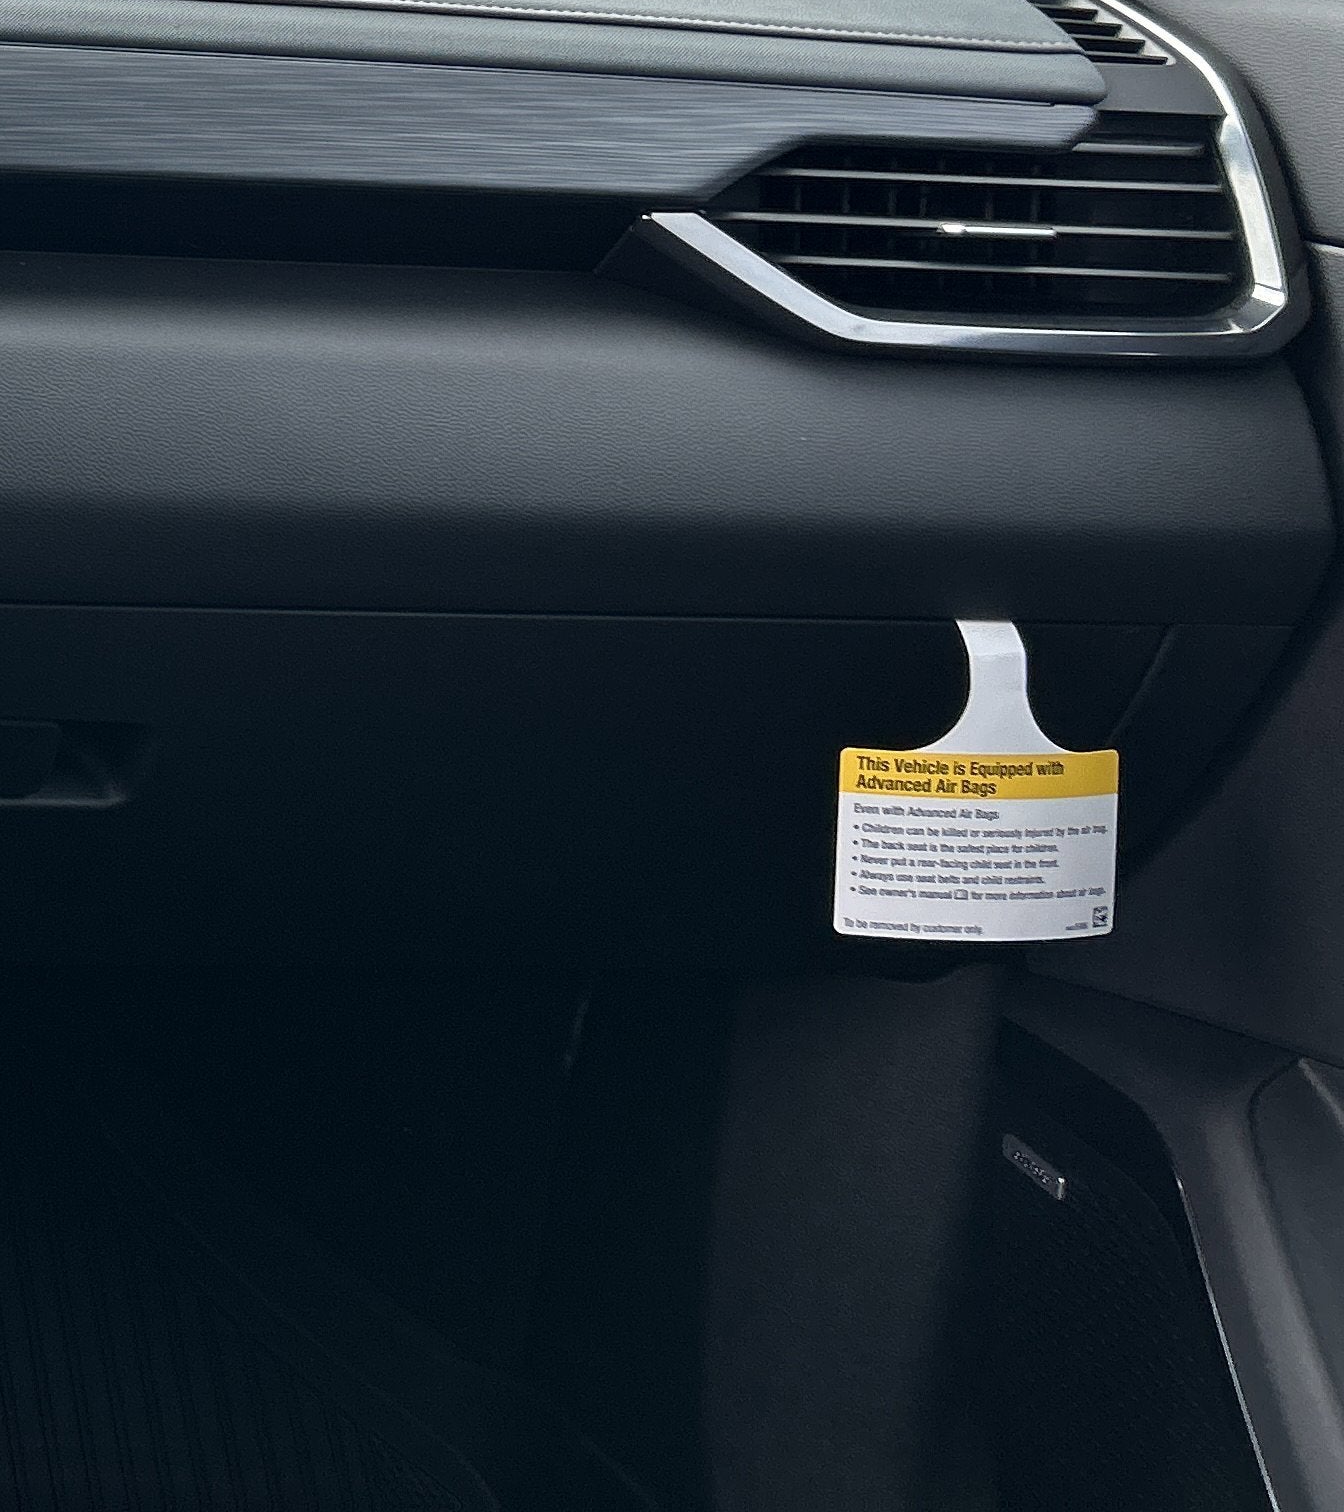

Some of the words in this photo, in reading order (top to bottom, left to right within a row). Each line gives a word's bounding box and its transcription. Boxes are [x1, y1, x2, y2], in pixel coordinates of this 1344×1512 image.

[856, 755, 890, 772] This
[894, 758, 949, 776] Vehicle
[954, 760, 966, 776] is
[970, 761, 1033, 779] Equipped
[1036, 760, 1064, 776] with
[856, 774, 931, 793] Advanced
[936, 778, 958, 793] Air
[960, 779, 997, 797] Bags
[854, 802, 880, 814] Even
[882, 805, 905, 816] with
[906, 806, 956, 818] Advanced
[958, 808, 972, 819] Air
[975, 808, 999, 821] Bags
[862, 823, 904, 834] Children
[927, 827, 940, 836] be
[941, 827, 968, 837] killed
[983, 829, 1022, 839] seriously
[1025, 828, 1053, 838] injured
[861, 838, 879, 848] The
[881, 840, 904, 850] back
[906, 843, 927, 851] seat
[929, 843, 938, 852] is
[940, 844, 955, 852] the
[957, 844, 985, 853] safest
[986, 845, 1009, 855] place
[1012, 844, 1022, 853] for
[860, 854, 888, 864] Never
[890, 858, 907, 867] put
[917, 859, 968, 870] rear-facing
[969, 860, 992, 868] child
[859, 869, 894, 882] Always
[895, 874, 913, 882] use
[916, 875, 936, 883] seat
[938, 875, 960, 884] belts
[962, 875, 979, 884] and
[981, 876, 1003, 884] child
[858, 885, 877, 896] See
[918, 891, 952, 900] manual
[971, 892, 982, 900] for
[1009, 891, 1053, 900] information
[844, 917, 854, 928] To
[856, 919, 868, 929] be
[869, 921, 909, 931] removed
[910, 923, 920, 934] by
[922, 924, 962, 934] customer
